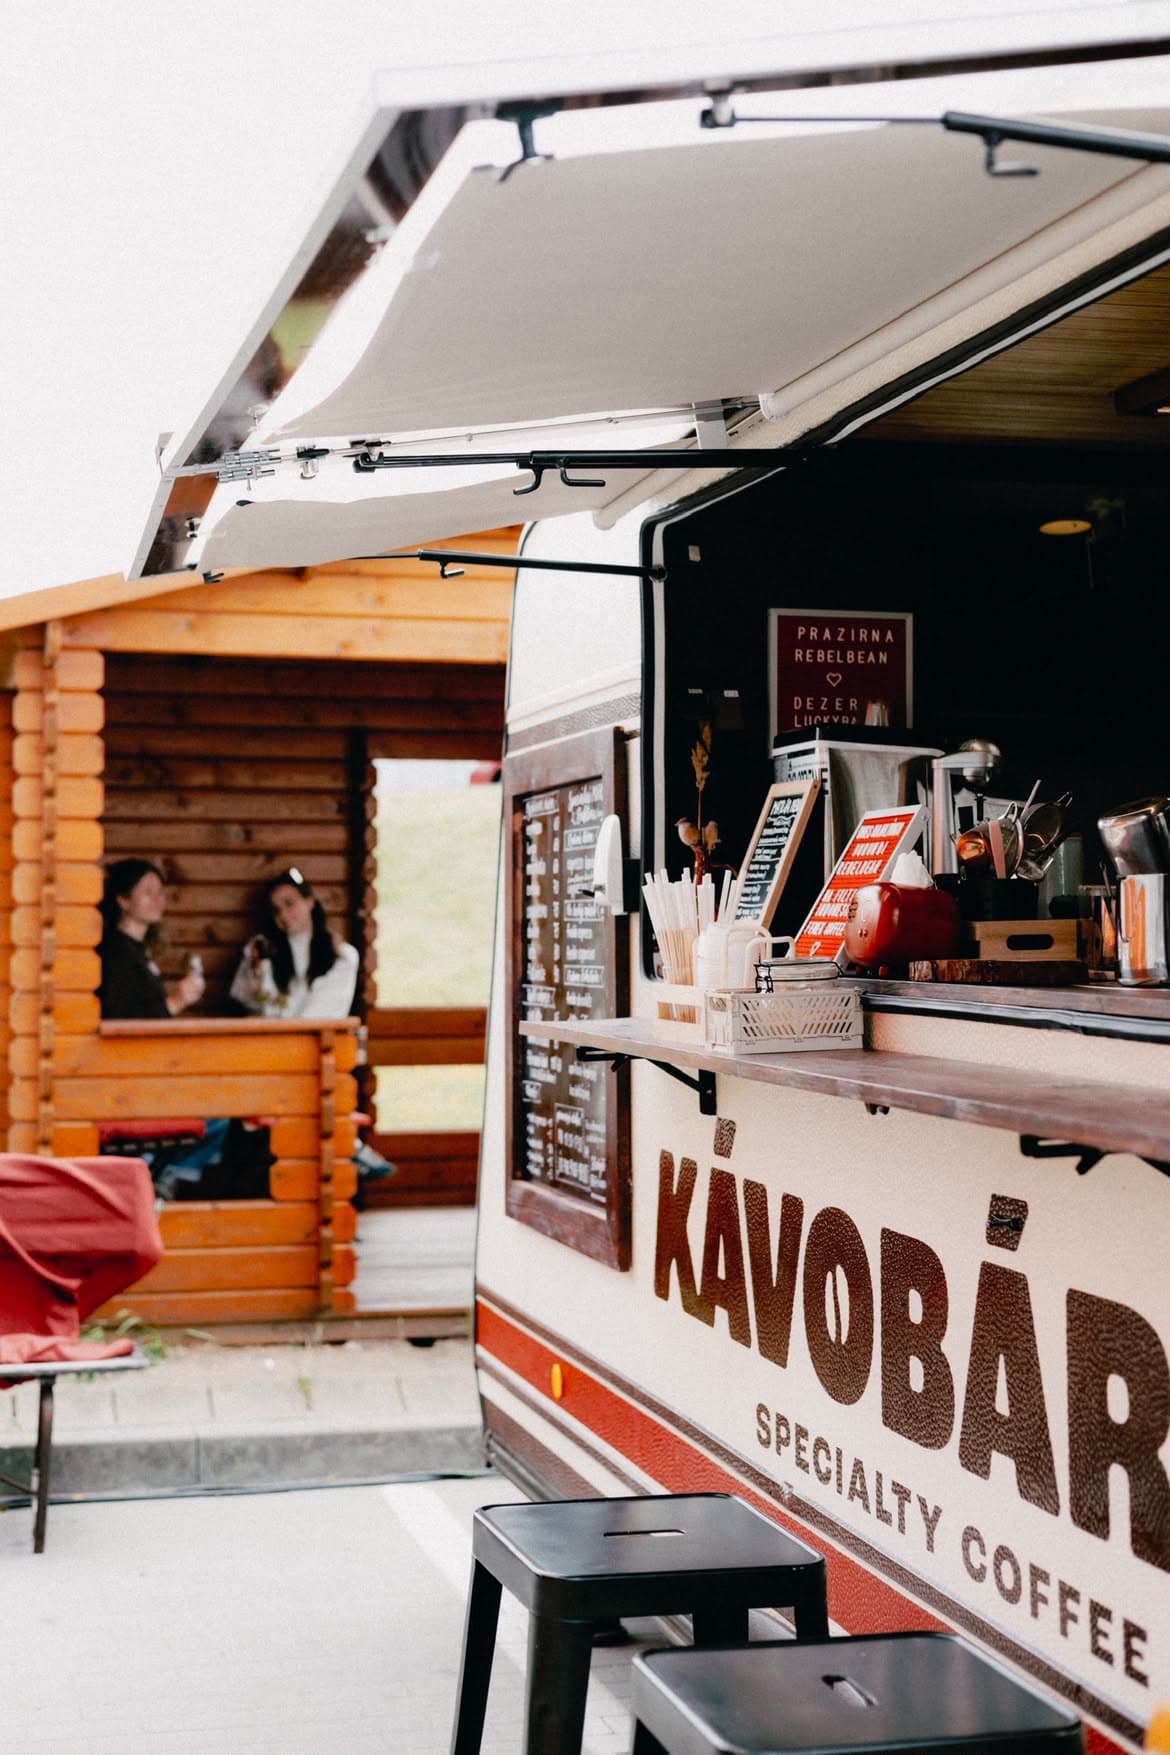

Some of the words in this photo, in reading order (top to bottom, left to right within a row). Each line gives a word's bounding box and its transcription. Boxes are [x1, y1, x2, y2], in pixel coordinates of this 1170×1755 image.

[794, 648, 888, 664] REBELBEAN
[797, 626, 894, 642] PRAZIRNA
[653, 1117, 1170, 1574] KÁVOBÁR
[755, 1402, 944, 1553] SPECIALTY
[960, 1524, 1150, 1688] COFFEE
